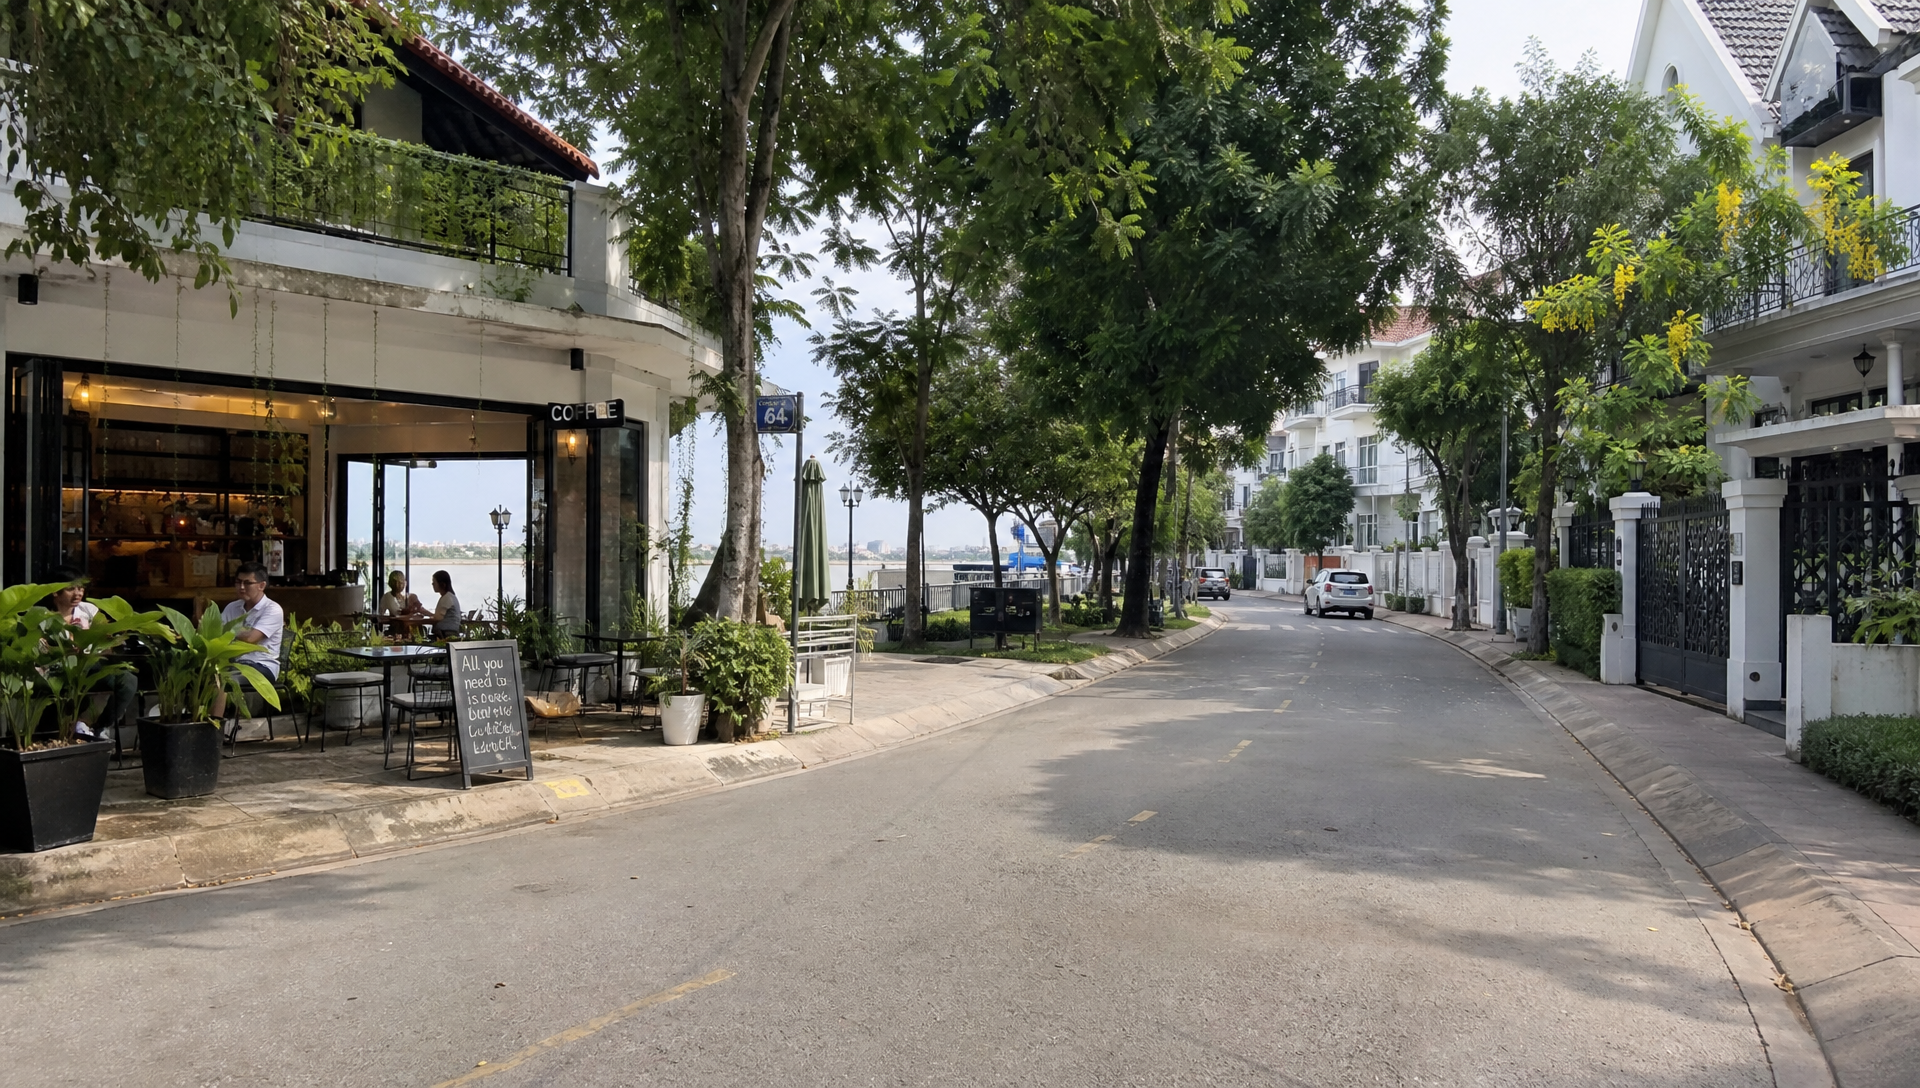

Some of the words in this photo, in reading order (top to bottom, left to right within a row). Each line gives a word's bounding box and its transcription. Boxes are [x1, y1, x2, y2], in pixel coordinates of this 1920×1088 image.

[551, 402, 618, 421] COFFE
[764, 407, 788, 424] 64
[461, 655, 480, 672] All
[483, 660, 503, 677] you
[464, 677, 492, 689] need
